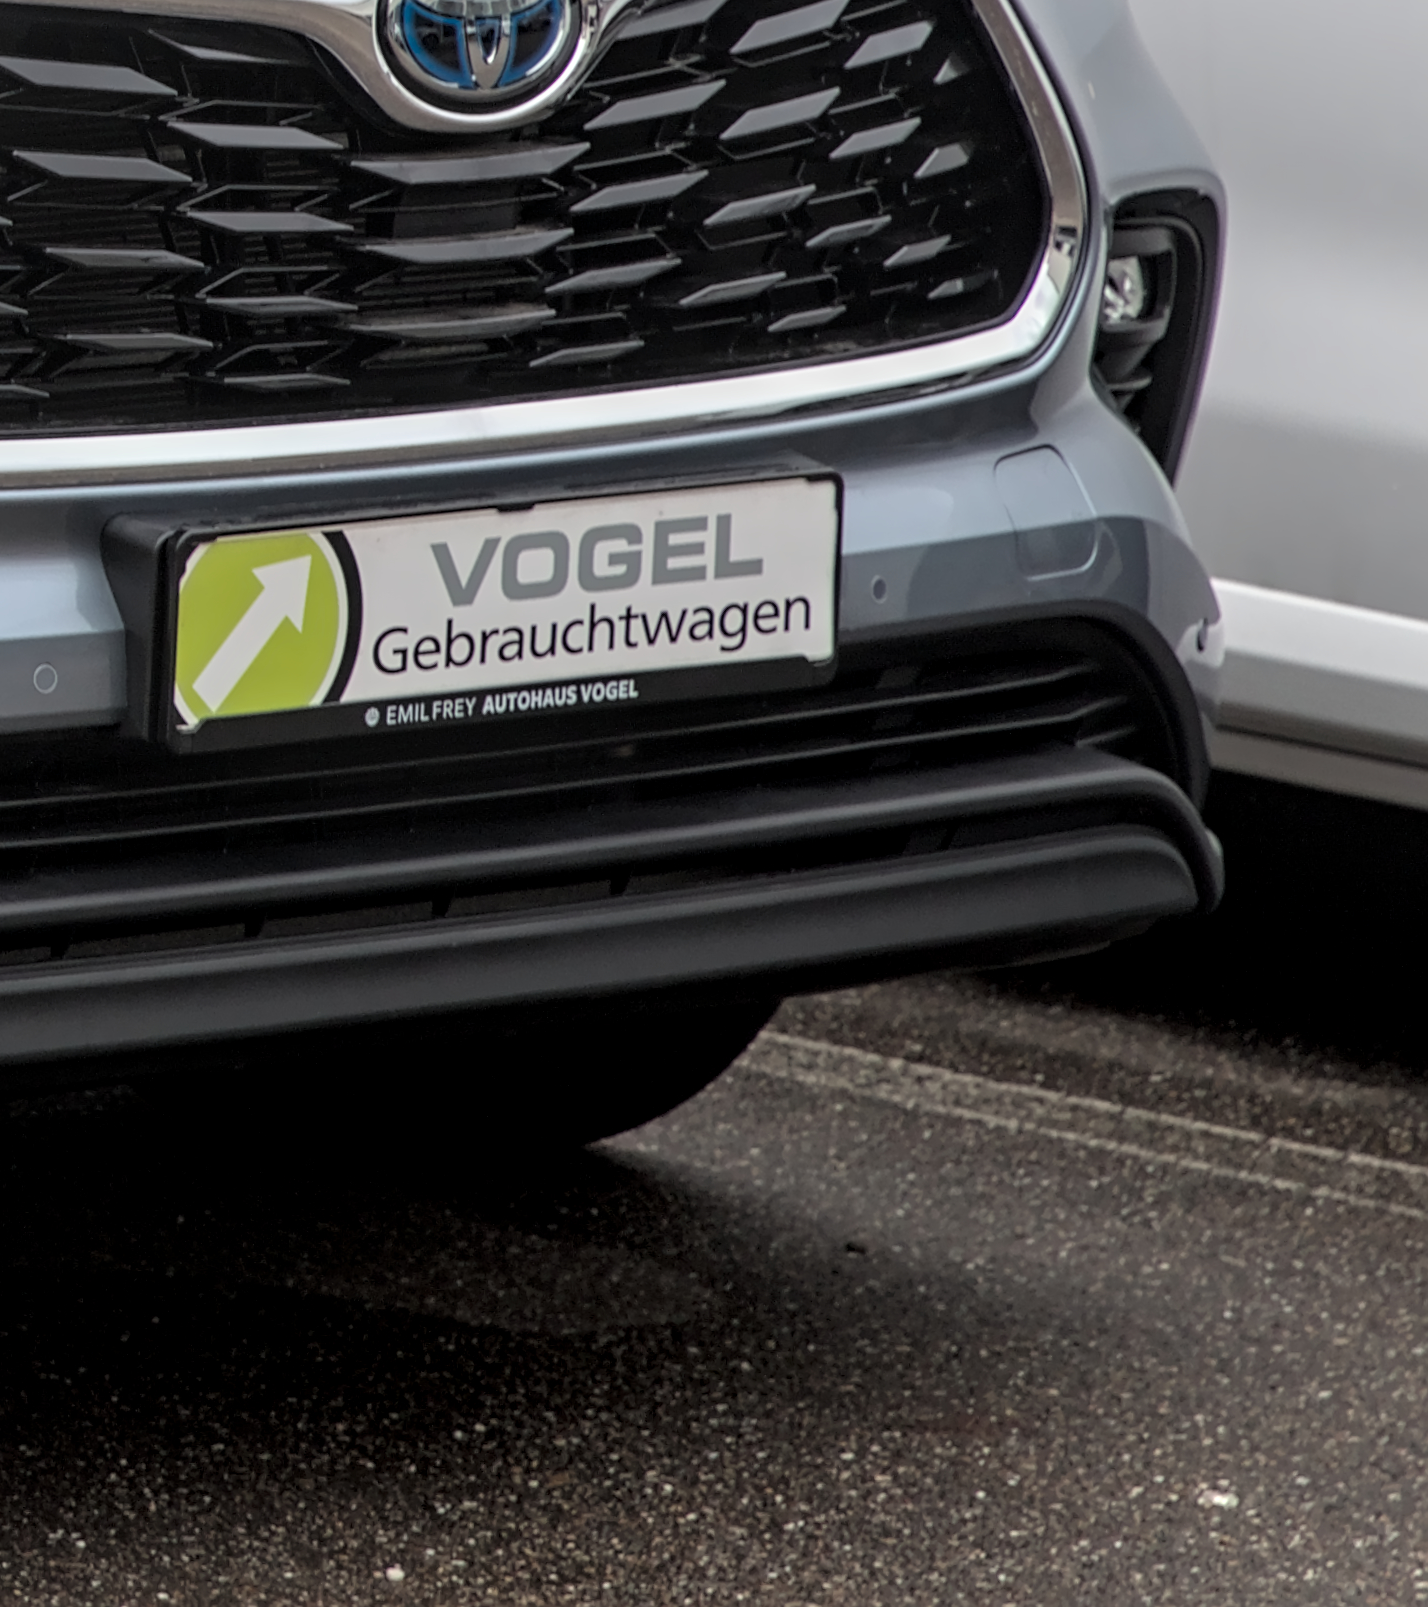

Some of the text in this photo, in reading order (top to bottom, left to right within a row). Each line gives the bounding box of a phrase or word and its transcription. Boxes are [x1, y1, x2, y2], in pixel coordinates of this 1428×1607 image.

[430, 513, 764, 608] VOGEL
[372, 596, 811, 675] Gebrauchtwagen
[385, 678, 640, 726] EMIL FREY AUTOHAUS VOGEL
